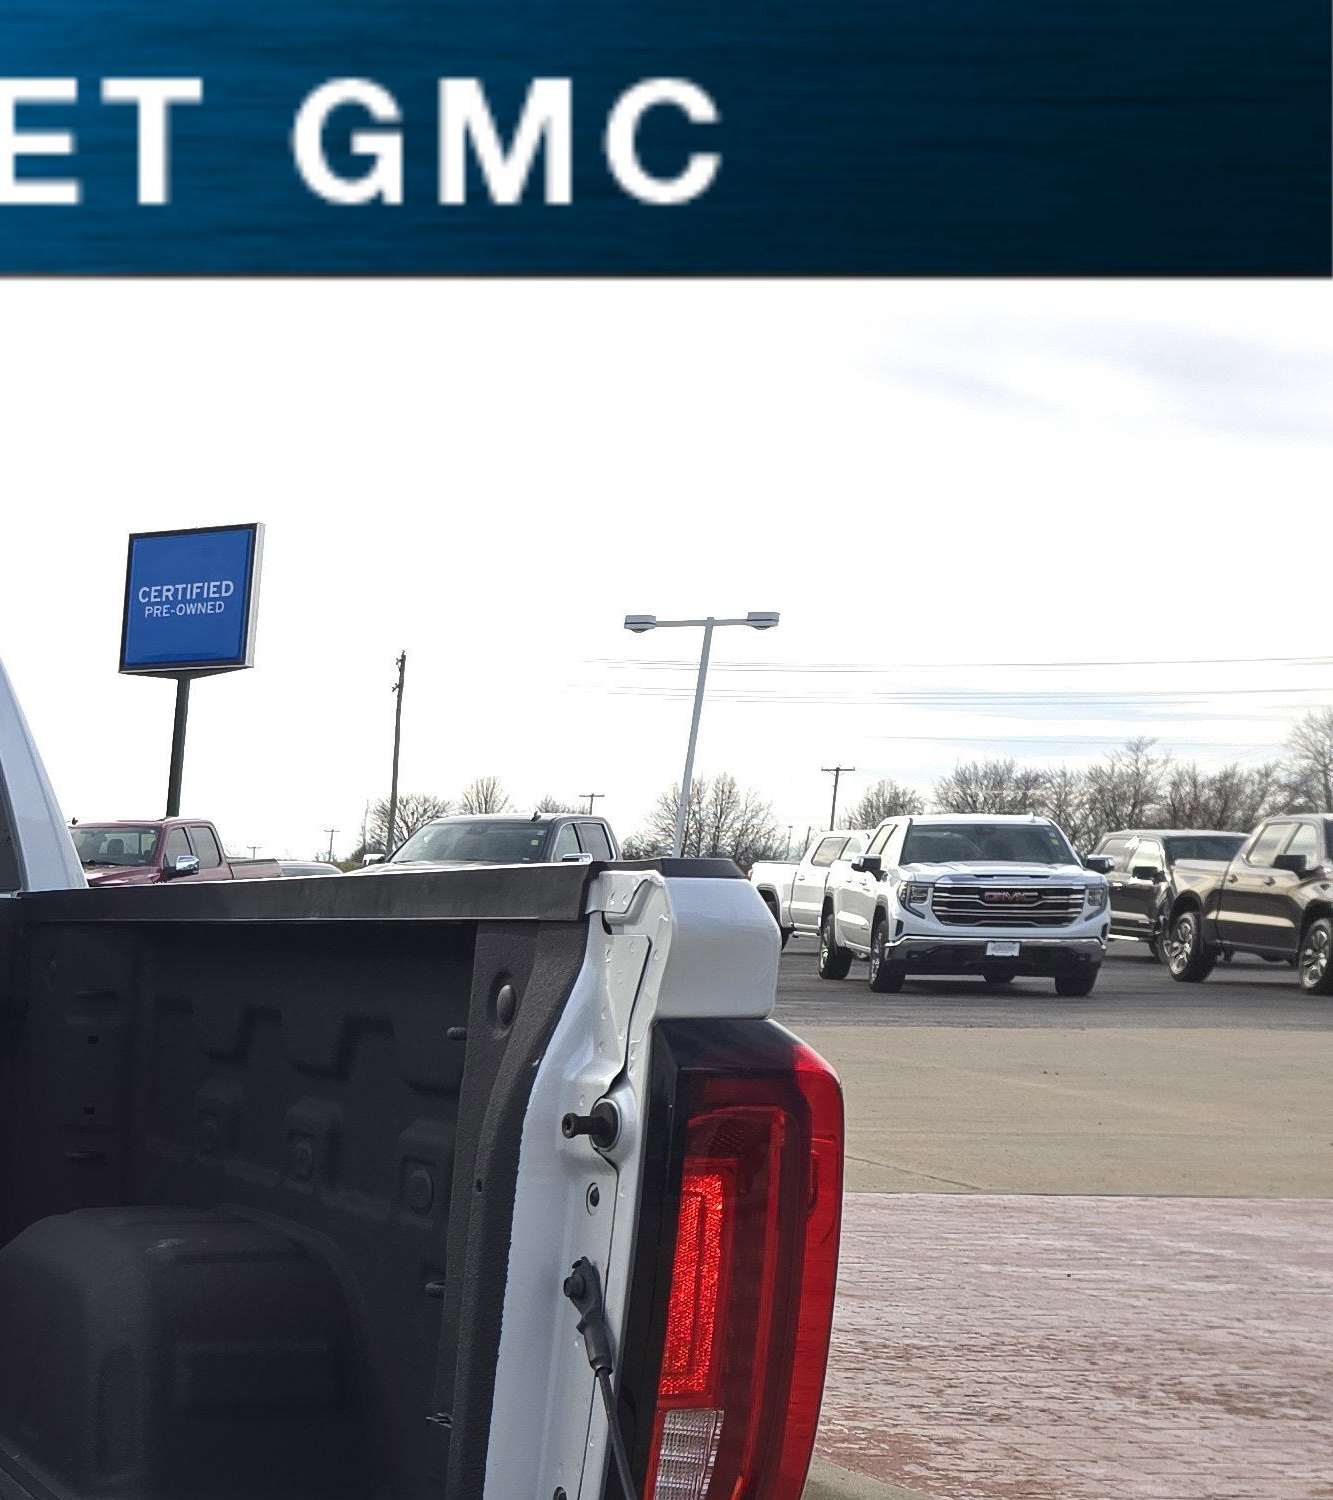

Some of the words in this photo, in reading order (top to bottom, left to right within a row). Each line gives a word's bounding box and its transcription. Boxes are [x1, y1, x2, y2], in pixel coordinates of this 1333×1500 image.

[138, 581, 234, 603] CERTIFIED
[144, 601, 225, 618] PRE-OWNED
[984, 891, 1039, 902] GMC
